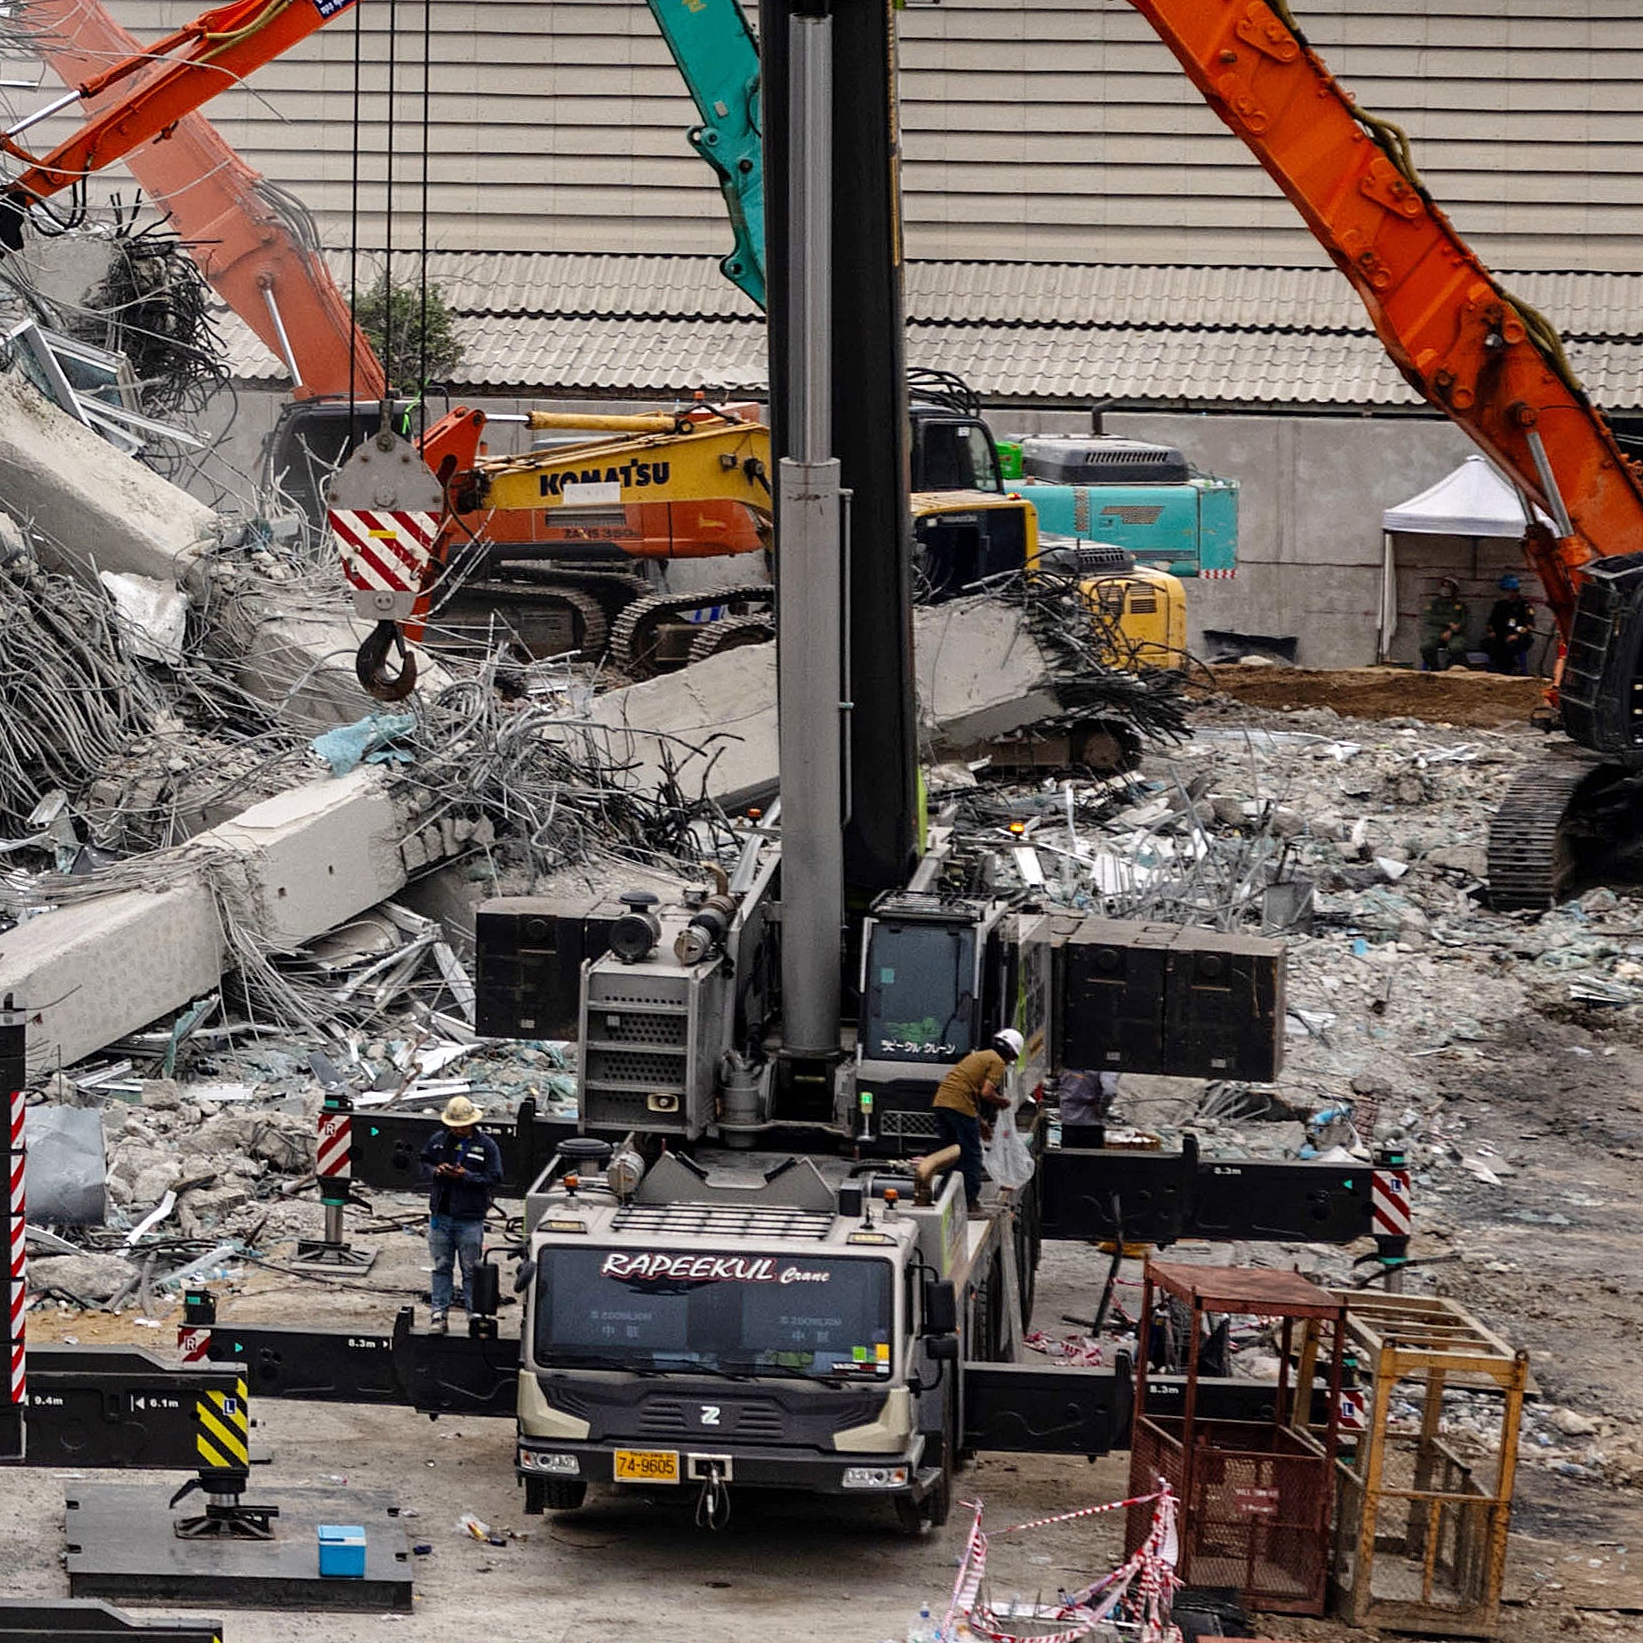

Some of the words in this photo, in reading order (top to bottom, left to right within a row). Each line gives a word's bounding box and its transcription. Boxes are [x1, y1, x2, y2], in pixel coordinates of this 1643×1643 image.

[325, 1123, 335, 1135] R
[602, 1253, 777, 1282] RAPEEKUL
[780, 1267, 830, 1284] Crane
[186, 1337, 196, 1350] R
[348, 1338, 376, 1349] 8.3m
[34, 1395, 64, 1406] 9.4m
[149, 1398, 179, 1408] 6.1m
[619, 1456, 675, 1475] 74-9605
